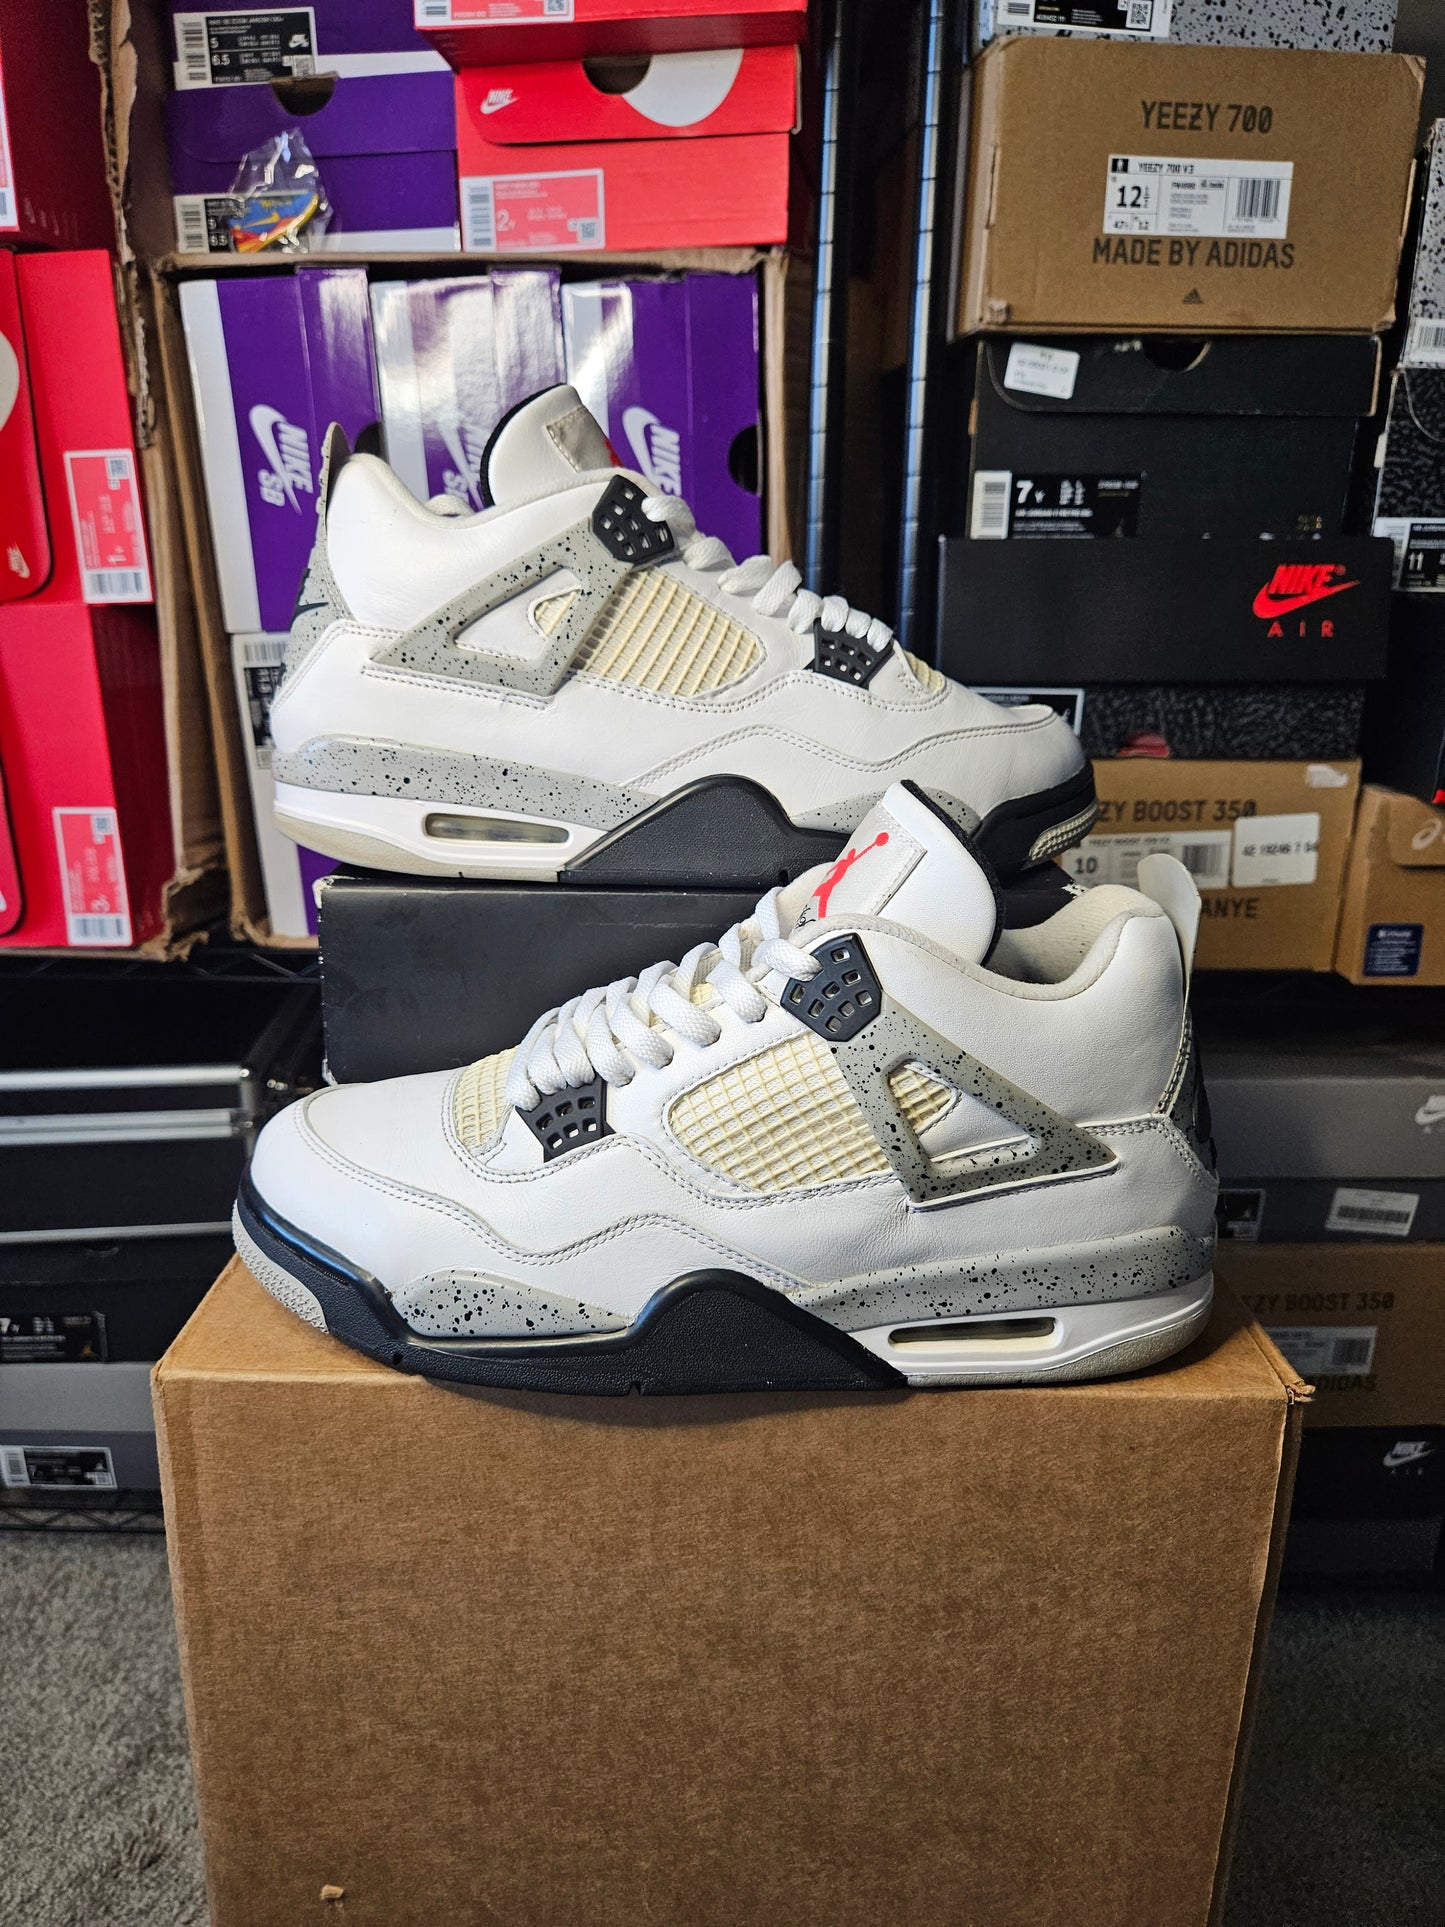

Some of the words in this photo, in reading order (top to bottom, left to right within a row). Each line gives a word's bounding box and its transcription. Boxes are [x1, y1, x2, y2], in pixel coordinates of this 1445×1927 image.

[486, 88, 514, 105] NIKE
[1141, 100, 1220, 132] YEEZY
[1227, 104, 1272, 133] 700
[1092, 238, 1162, 267] MADE
[1168, 240, 1201, 267] BY
[1205, 240, 1296, 269] ADIDAS
[277, 422, 314, 494] NIKE
[649, 424, 682, 497] NIKE
[257, 469, 286, 507] SB
[1268, 564, 1336, 595] NIKE
[1267, 620, 1335, 638] AIR
[1133, 799, 1207, 822] BOOST
[1073, 856, 1099, 875] 10
[1201, 898, 1259, 919] ANYE
[1285, 1291, 1352, 1313] BOOST
[1356, 1291, 1395, 1312] 350
